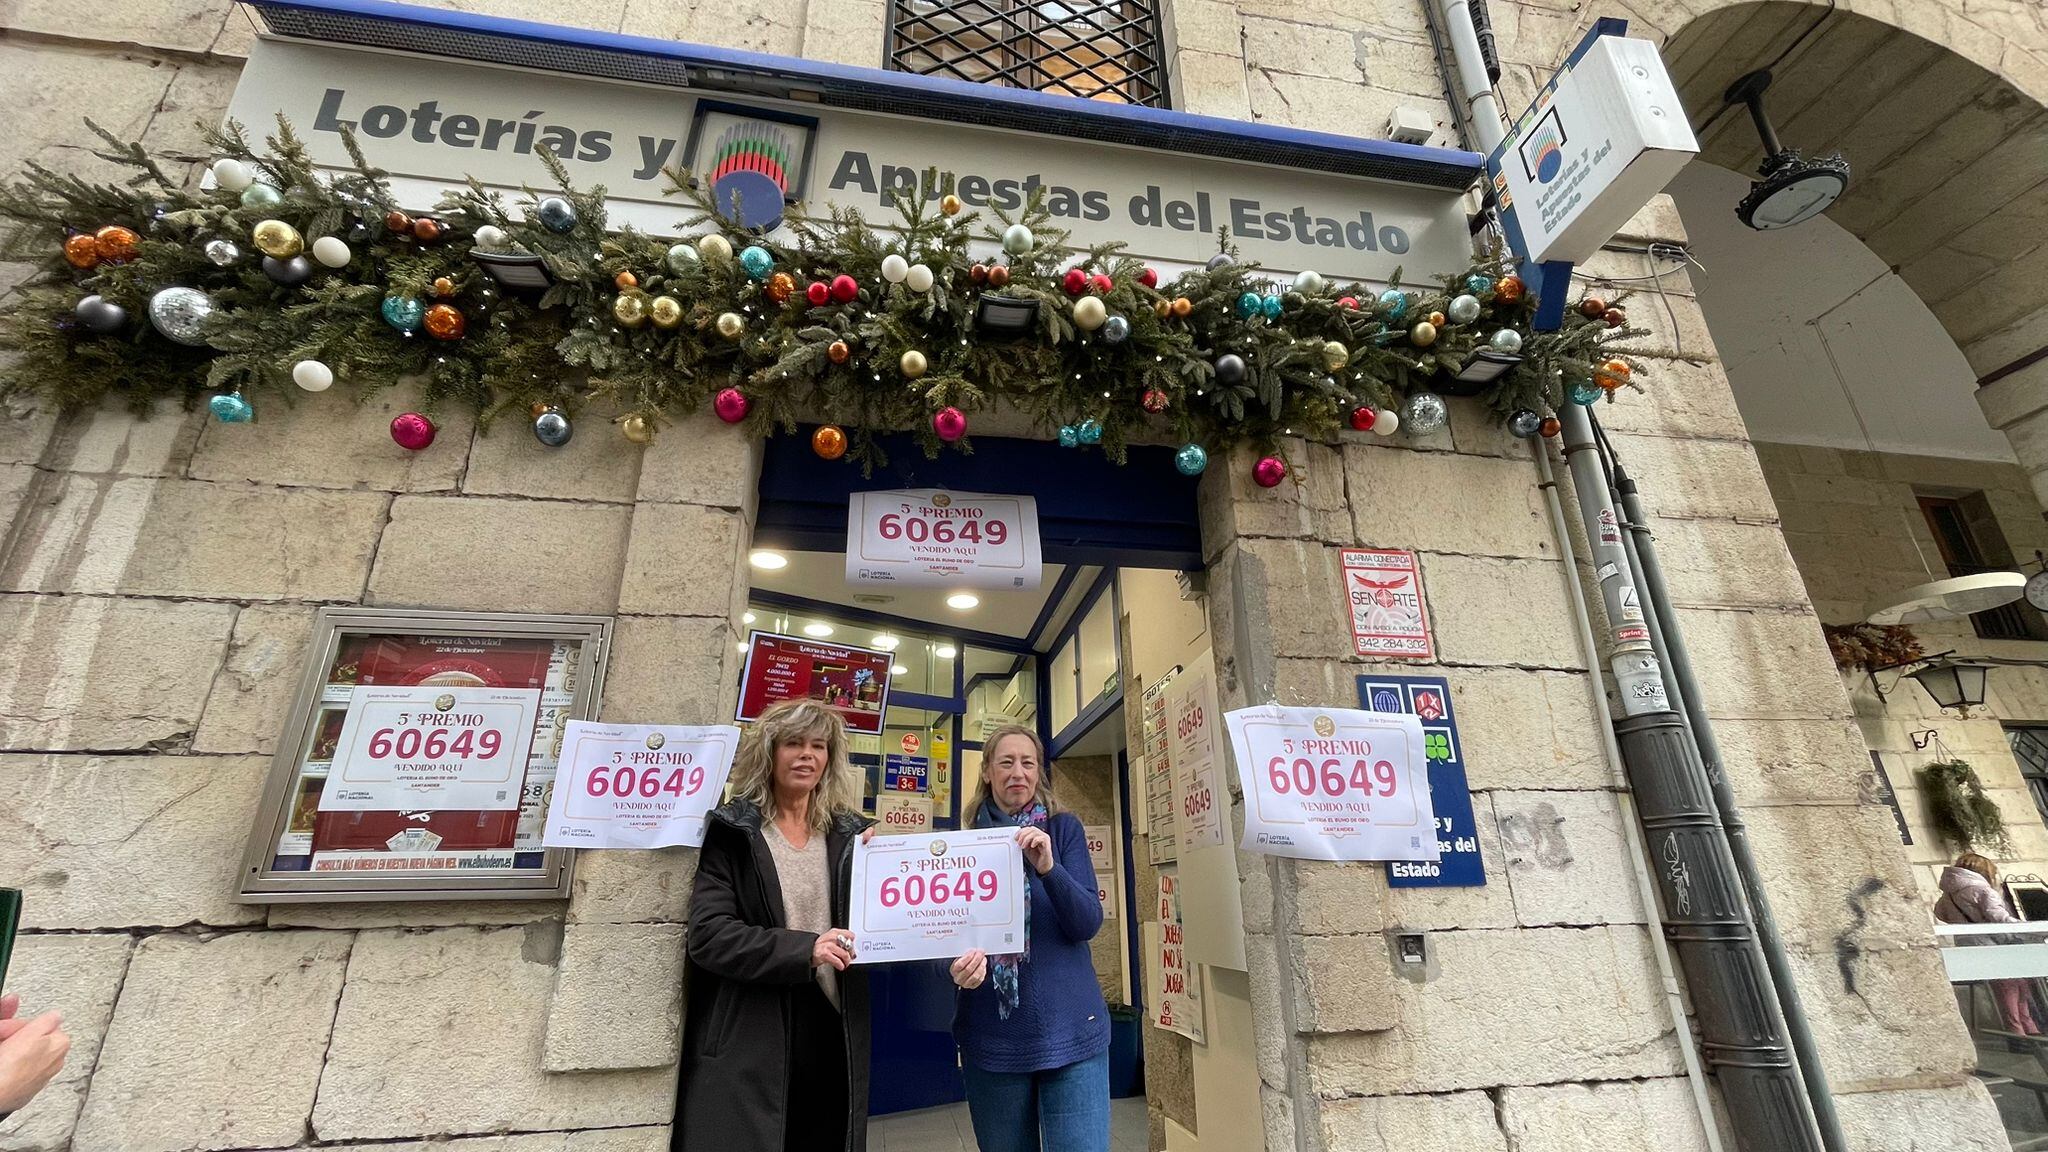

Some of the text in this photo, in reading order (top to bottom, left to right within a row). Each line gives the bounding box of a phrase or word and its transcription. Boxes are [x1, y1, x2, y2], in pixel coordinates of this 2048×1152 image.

[313, 88, 675, 180] Loterías y
[1536, 148, 1589, 209] Loterías y
[1542, 139, 1612, 222] Apuestas del
[828, 151, 1410, 255] Apuestas del Estado
[1544, 192, 1582, 234] Estado
[919, 506, 983, 519] PREMIO
[879, 513, 1008, 545] 60649
[1345, 554, 1372, 562] ALARMA
[1619, 629, 1641, 638] Sprint
[468, 638, 502, 646] Navidad
[1359, 637, 1380, 648] 942
[1383, 638, 1403, 649] 284
[1406, 639, 1426, 650] 302
[777, 655, 799, 664] GORDO
[418, 713, 483, 726] PREMIO
[1178, 706, 1203, 740] 60649
[368, 728, 502, 760] 60649
[1302, 740, 1372, 756] PREMIO
[631, 752, 692, 765] PREMIO
[394, 763, 436, 771] VENDIDO
[898, 766, 926, 776] JUEVES
[586, 766, 705, 798] 60649
[901, 778, 914, 790] 3€
[1268, 756, 1397, 798] 60649
[613, 802, 652, 810] VENDIDO
[1184, 788, 1211, 818] 60649
[1301, 802, 1343, 811] VENDIDO
[886, 811, 926, 825] 60649
[1444, 818, 1452, 832] y
[1455, 836, 1477, 852] del
[316, 860, 340, 870] CONSULTA
[917, 856, 977, 871] PREMIO
[1392, 862, 1440, 877] Estado
[880, 869, 998, 908] 60649
[907, 909, 945, 918] VENDIDO
[1163, 924, 1183, 945] JUEGO
[1163, 949, 1176, 969] NO
